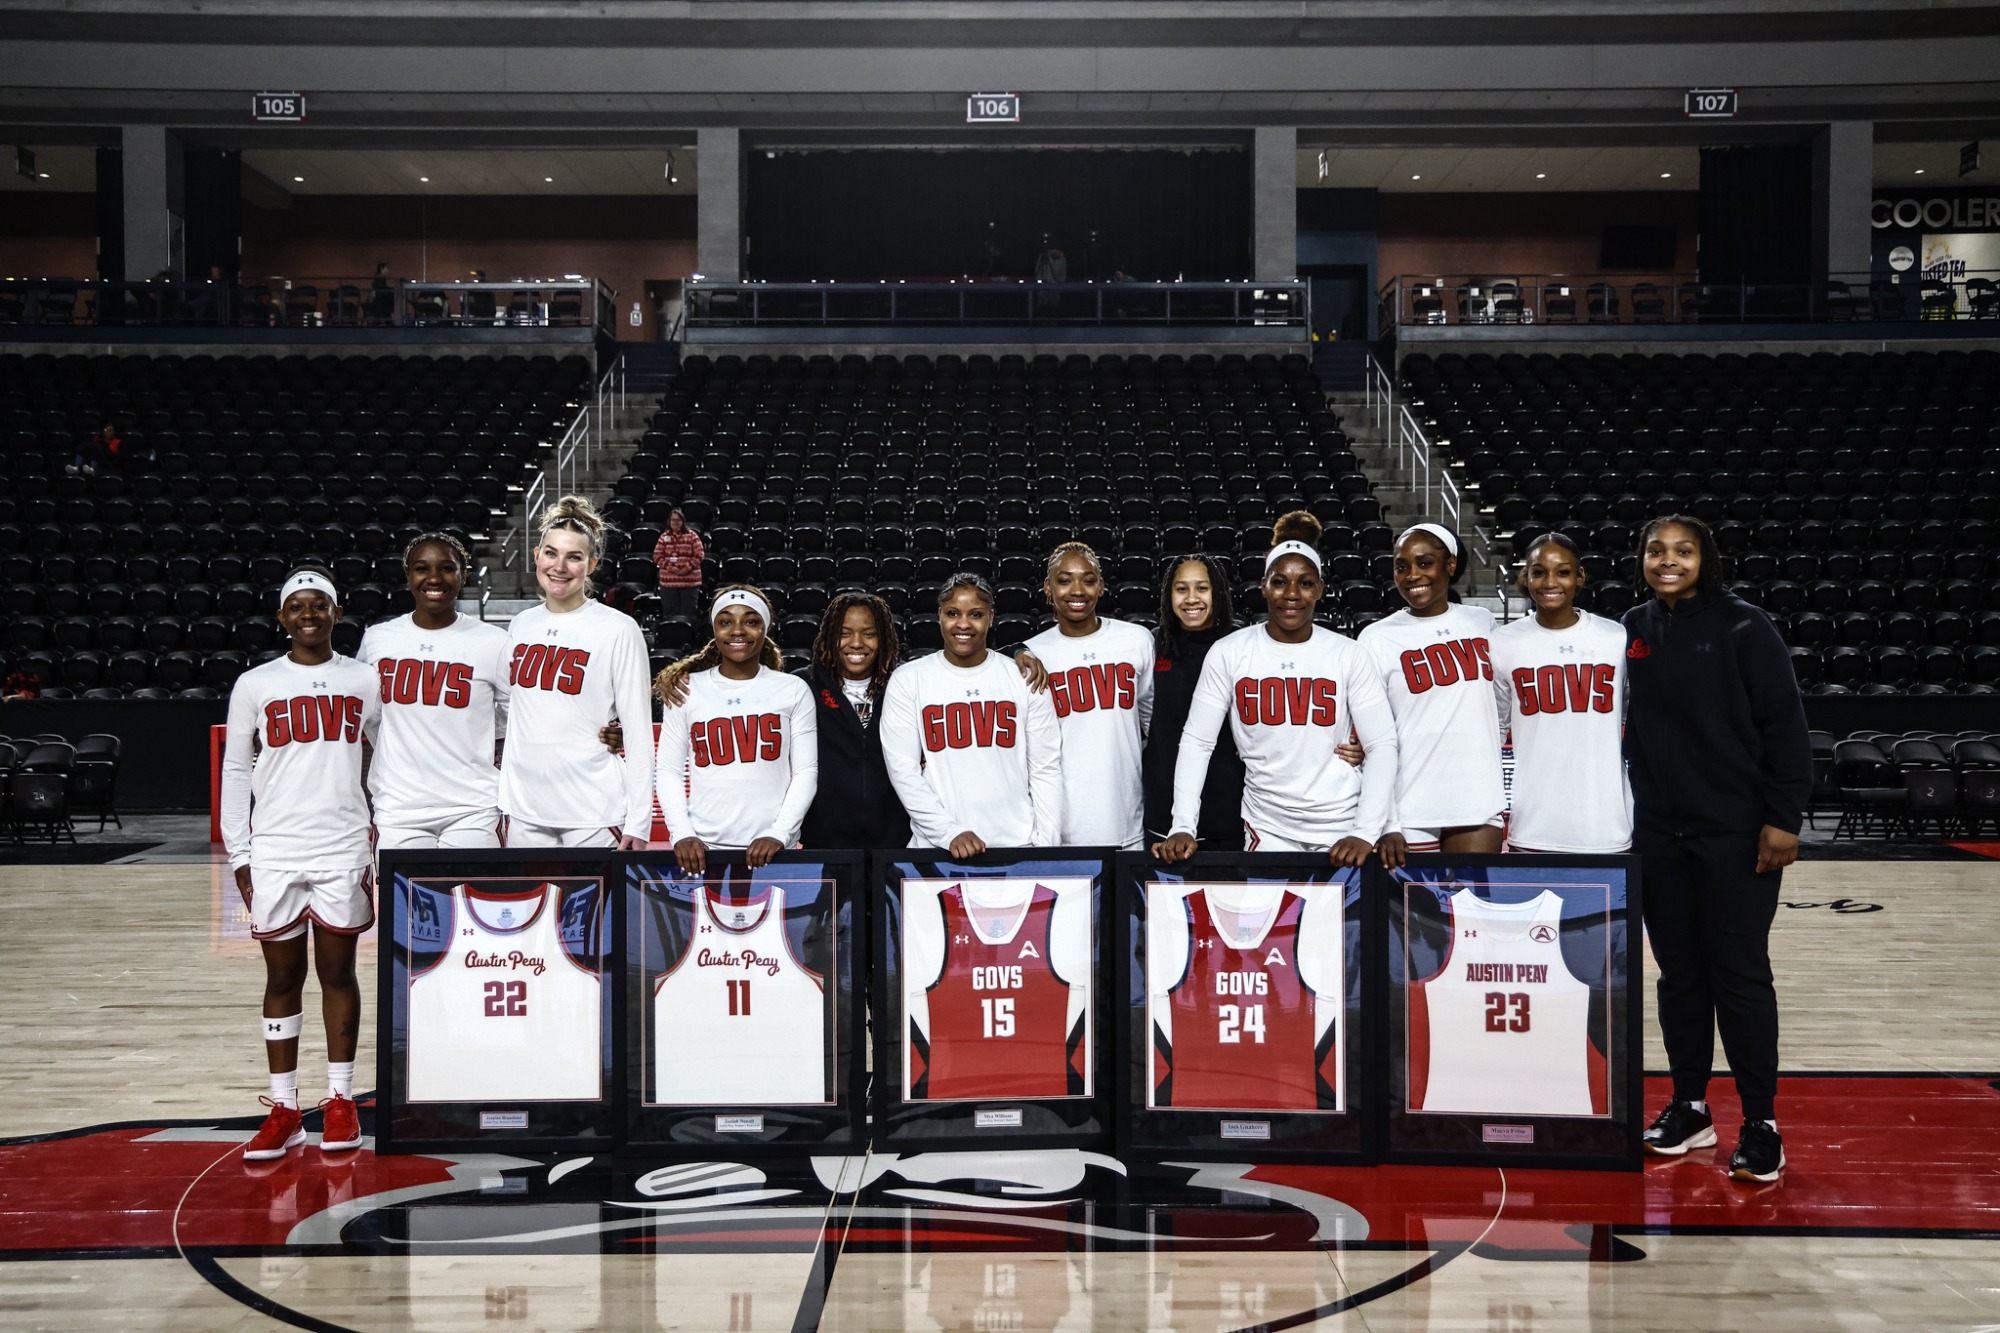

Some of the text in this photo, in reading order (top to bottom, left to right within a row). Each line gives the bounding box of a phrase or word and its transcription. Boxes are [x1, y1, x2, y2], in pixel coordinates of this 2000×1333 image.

[262, 98, 295, 115] 105
[977, 100, 1009, 116] 106
[1696, 95, 1727, 111] 107
[1872, 198, 2000, 228] COOLER
[379, 658, 474, 709] GOVS
[509, 643, 591, 696] GOVS
[1400, 636, 1494, 695] GOVS
[1048, 662, 1136, 718] GOVS
[1234, 676, 1337, 727] GOVS
[1512, 663, 1616, 716] GOVS
[264, 694, 364, 748] GOVS
[922, 700, 1018, 753] GOVS
[690, 713, 783, 768] GOVS
[1926, 786, 1935, 798] 2
[1985, 787, 1996, 799] 3
[465, 950, 546, 976] Austin Peay
[697, 948, 780, 977] Austin Peay
[972, 965, 1023, 990] GOVS
[1466, 963, 1549, 984] AUSTIN PEAY
[484, 980, 528, 1017] 22
[726, 979, 751, 1016] 11
[1216, 971, 1268, 996] GOVS
[981, 998, 1016, 1038] 15
[1218, 1004, 1267, 1045] 24
[1485, 992, 1531, 1033] 23
